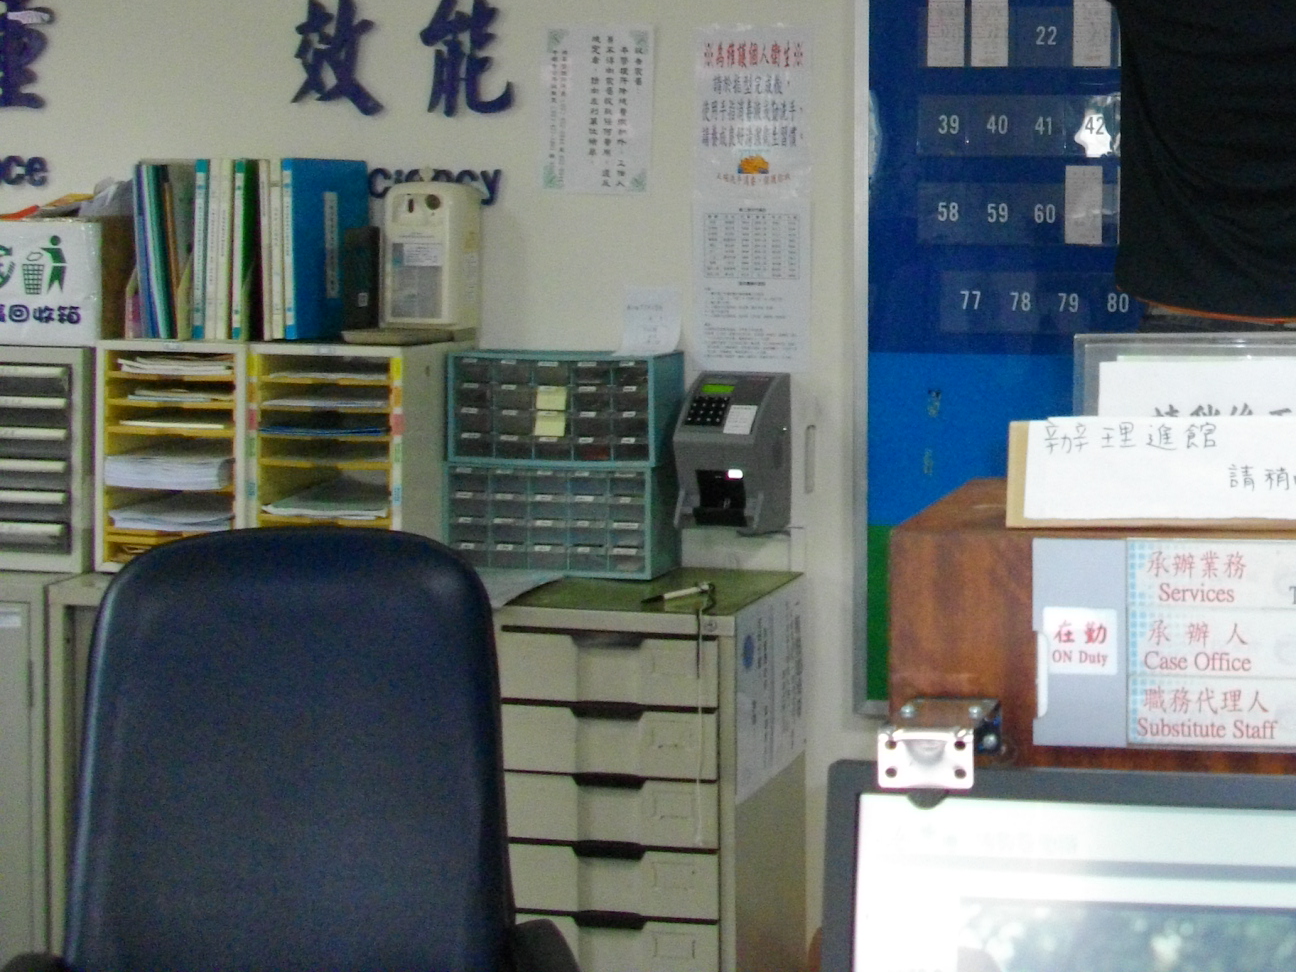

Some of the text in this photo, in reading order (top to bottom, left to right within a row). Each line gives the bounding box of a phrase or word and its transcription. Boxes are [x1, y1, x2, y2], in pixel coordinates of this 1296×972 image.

[1036, 26, 1057, 46] 22
[938, 114, 959, 135] 39
[987, 115, 1008, 135] 40
[1035, 116, 1053, 135] 41
[1085, 116, 1105, 135] 42
[938, 202, 959, 222] 58
[987, 203, 1008, 223] 59
[1034, 204, 1056, 223] 60
[960, 290, 981, 310] 77
[1010, 292, 1031, 312] 78
[1058, 293, 1079, 313] 79
[1107, 293, 1129, 313] 80
[0, 303, 82, 325] 回收箱
[1147, 550, 1247, 579] 承辦業務
[1158, 582, 1236, 603] Services
[1053, 619, 1108, 645] 在勤
[1148, 619, 1249, 647] 承辦人
[1052, 649, 1109, 668] ON Duty
[1143, 650, 1252, 673] Case Office
[1143, 686, 1270, 715] 職務代理人
[1137, 717, 1279, 740] Substitute Staff
